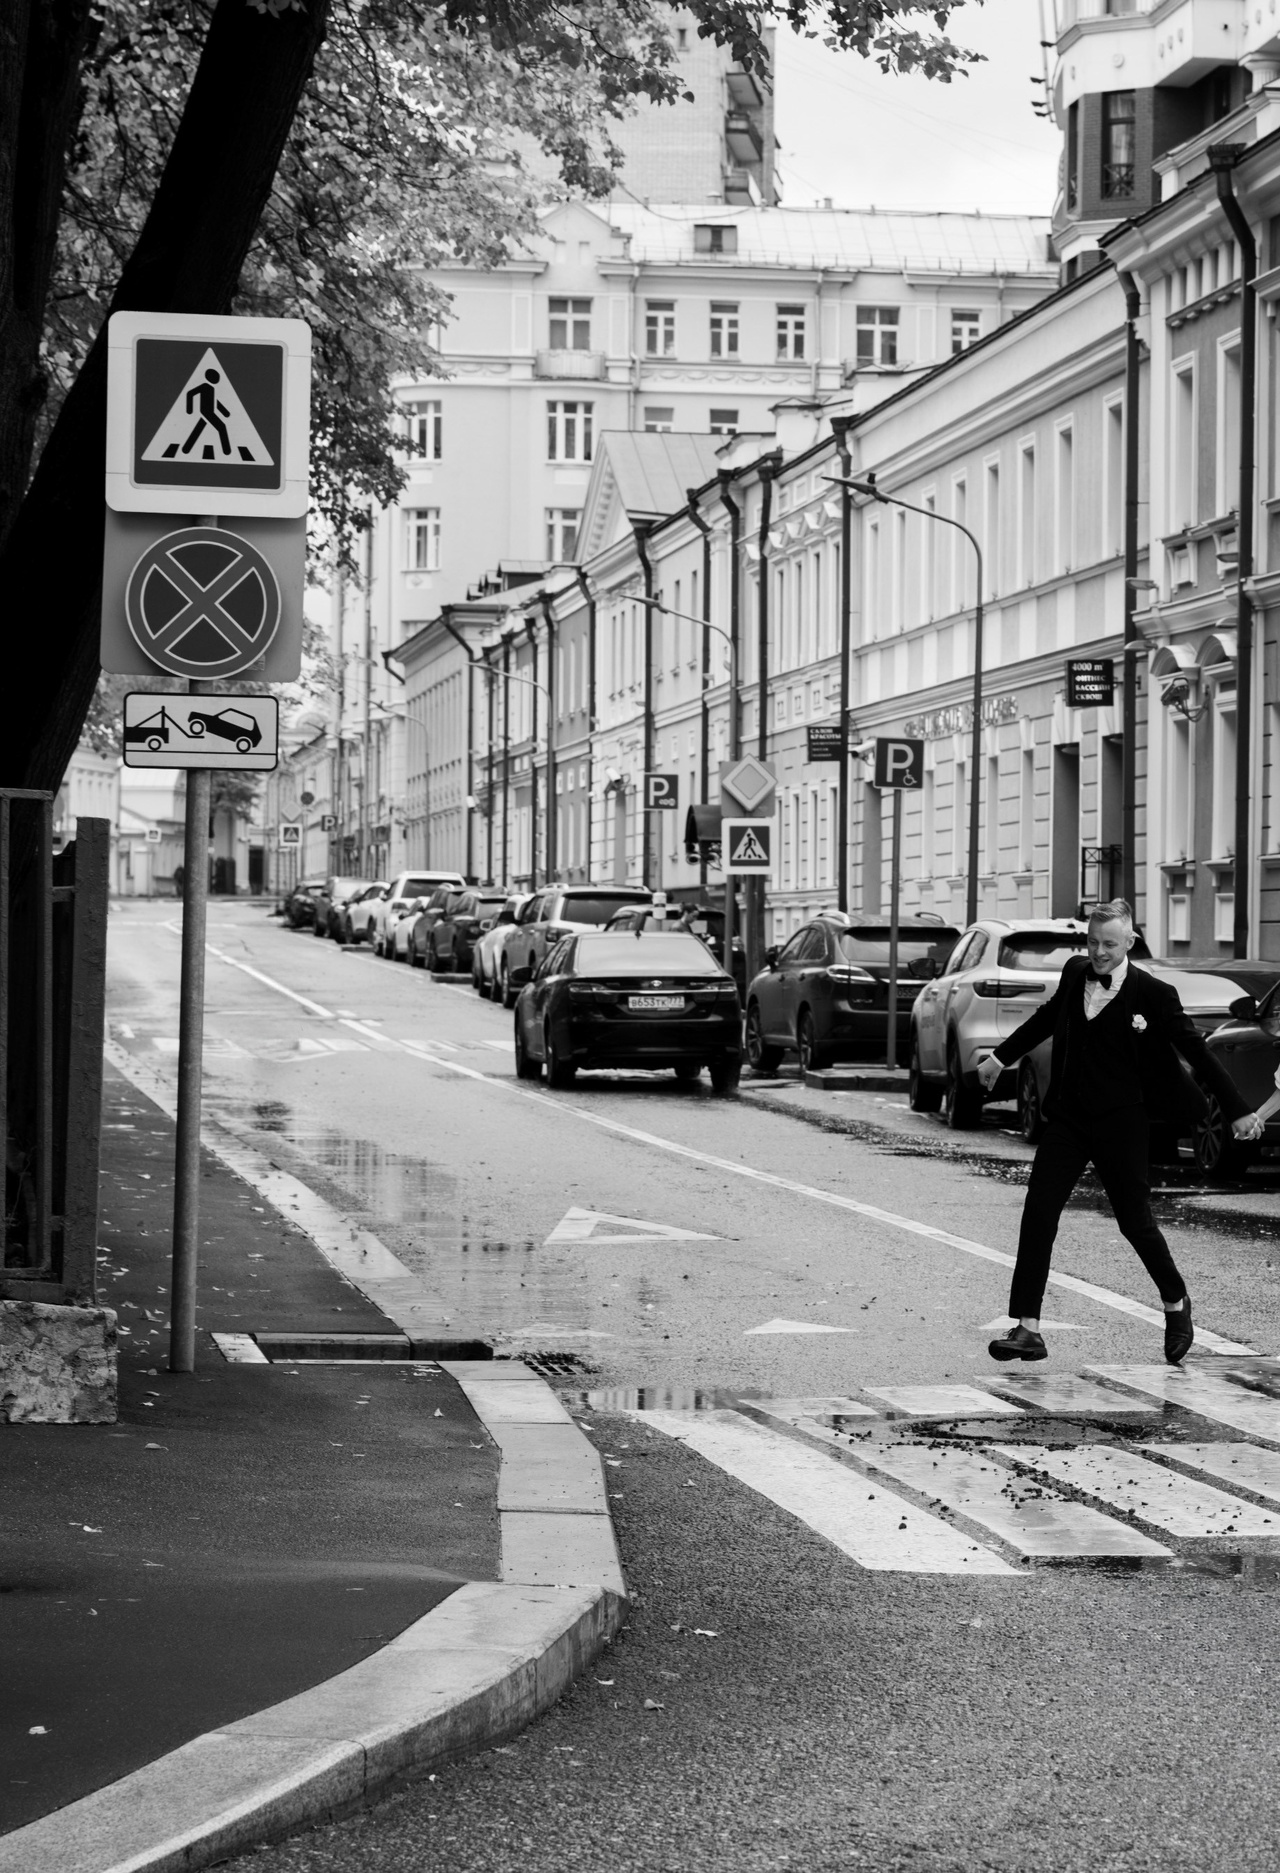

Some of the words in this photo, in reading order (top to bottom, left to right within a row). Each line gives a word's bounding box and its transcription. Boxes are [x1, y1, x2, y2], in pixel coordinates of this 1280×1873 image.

[1072, 662, 1092, 671] 4000
[886, 743, 914, 783] P
[649, 777, 669, 806] P
[324, 816, 336, 830] P
